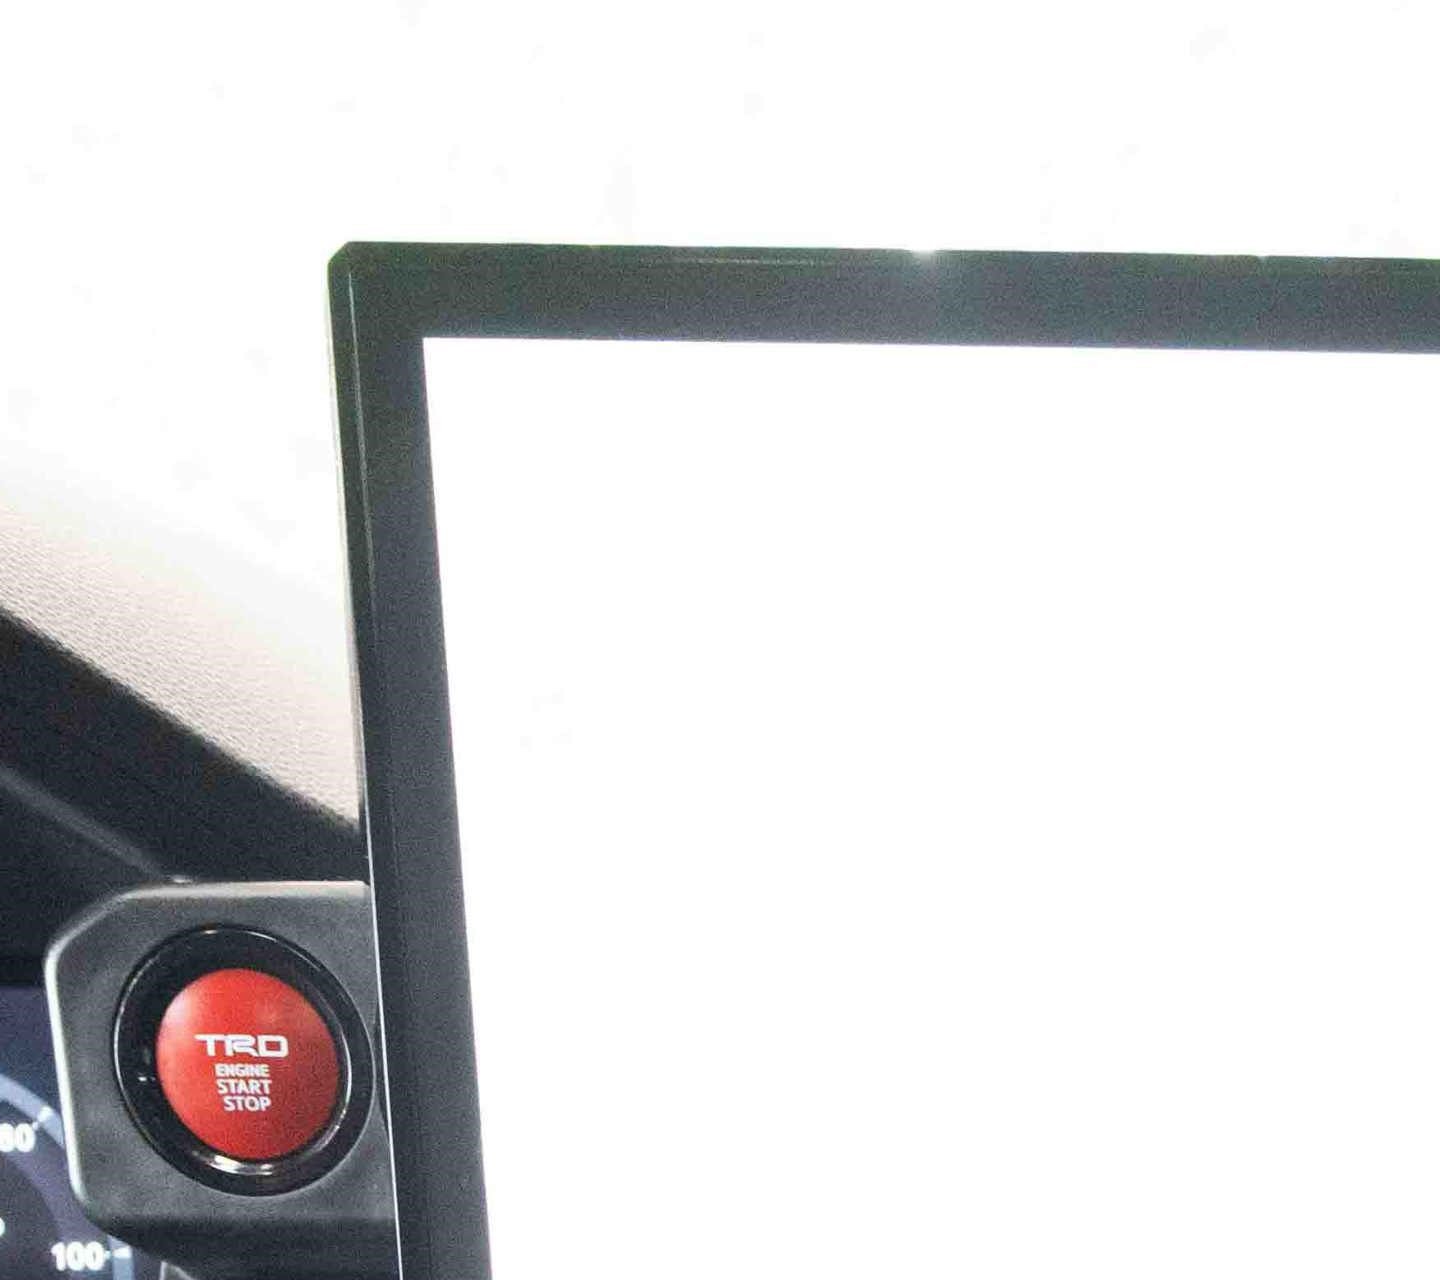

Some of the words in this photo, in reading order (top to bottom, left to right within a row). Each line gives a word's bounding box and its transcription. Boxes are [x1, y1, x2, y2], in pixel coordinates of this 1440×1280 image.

[195, 1034, 288, 1058] TRD
[215, 1063, 270, 1078] ENGINE
[217, 1079, 271, 1096] START
[223, 1095, 271, 1112] STOP
[50, 1241, 106, 1272] 100
